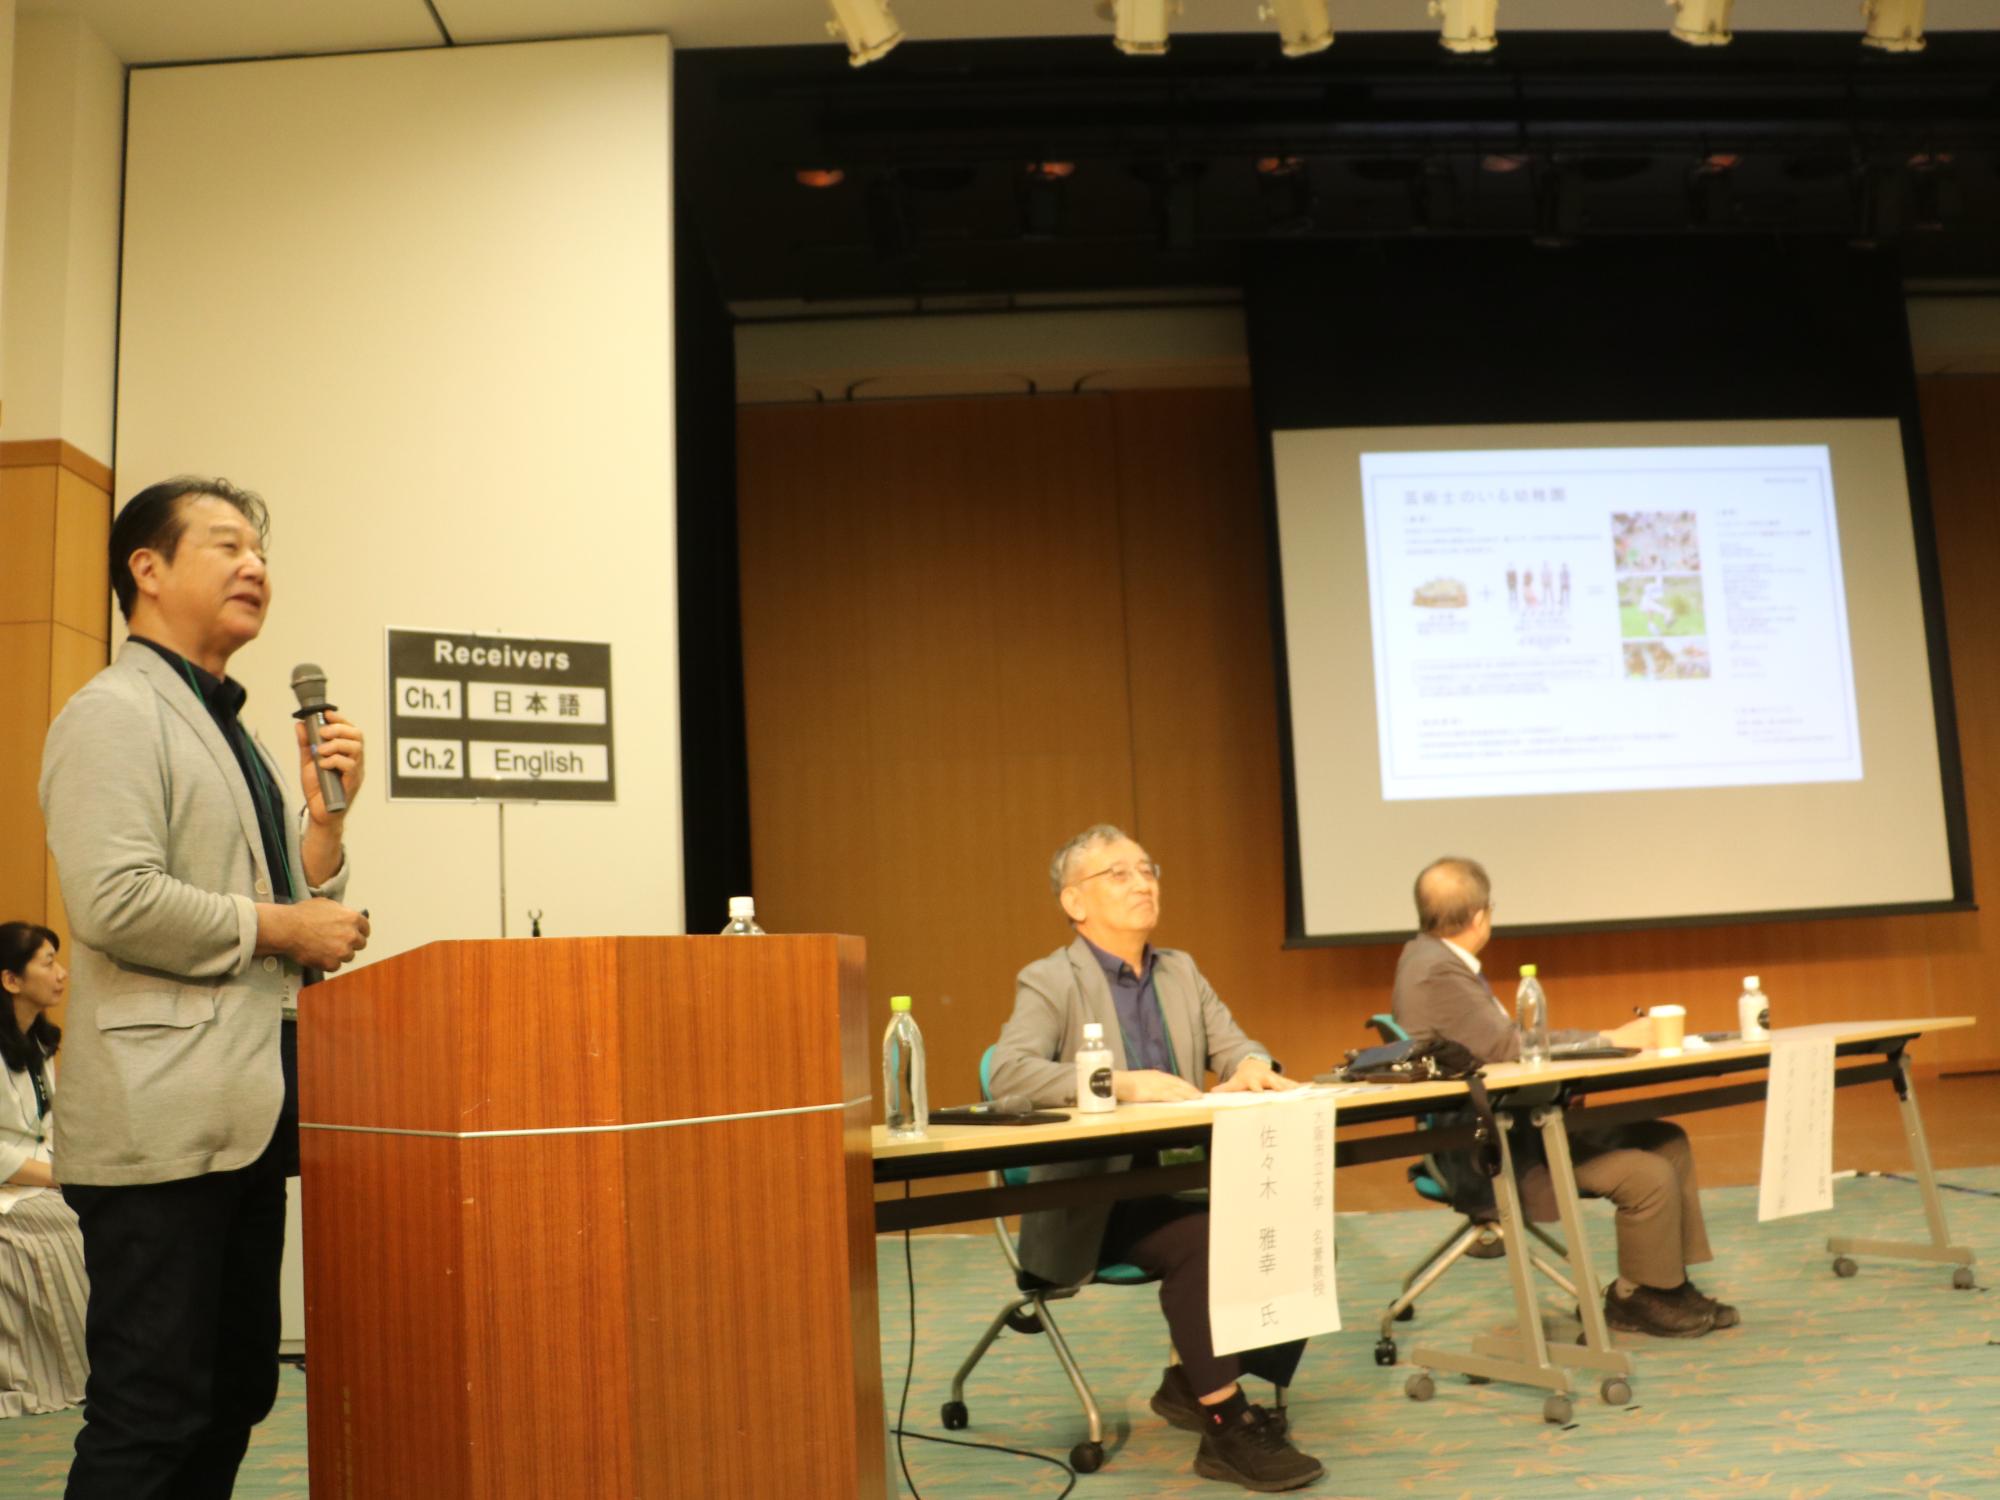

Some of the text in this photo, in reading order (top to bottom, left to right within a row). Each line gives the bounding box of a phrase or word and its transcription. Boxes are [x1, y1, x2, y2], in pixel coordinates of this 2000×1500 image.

[434, 640, 570, 671] Receivers
[405, 686, 452, 711] Ch.1
[494, 690, 580, 717] 日本語
[406, 747, 456, 771] Ch.2
[494, 748, 583, 778] English
[1258, 1125, 1279, 1329] 佐々木 雅幸 氏
